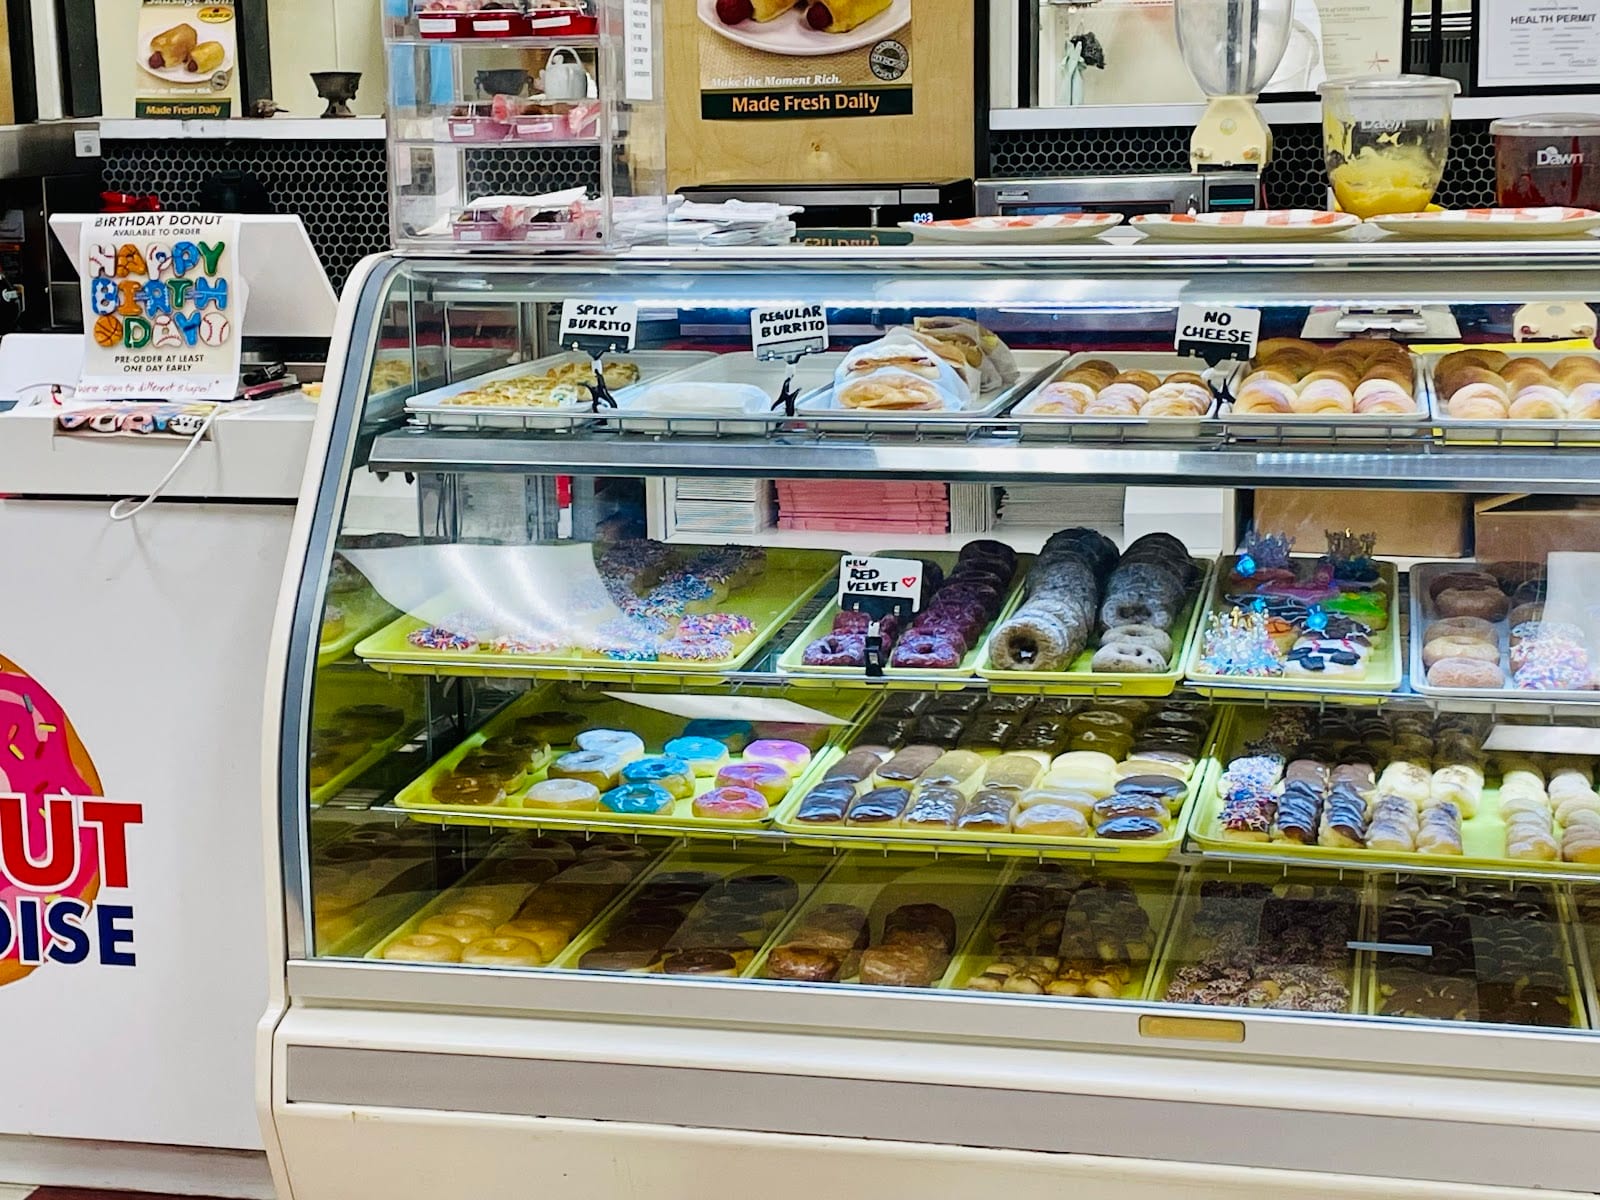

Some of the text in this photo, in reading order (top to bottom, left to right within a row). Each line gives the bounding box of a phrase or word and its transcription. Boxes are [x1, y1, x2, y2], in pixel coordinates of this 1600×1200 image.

[1510, 14, 1597, 24] HEALTH PERMIT
[711, 74, 842, 87] Make the Moment Rich.
[732, 93, 880, 113] Made Fresh Daily
[145, 105, 221, 116] Made Fresh Daily
[1537, 149, 1584, 165] Dawn
[95, 215, 223, 227] BIRTHDAY DONUT
[113, 229, 156, 237] AVAILABLE
[89, 241, 226, 280] HAPPY
[92, 277, 228, 318] BIRTH
[577, 304, 618, 316] SPICY
[759, 305, 822, 324] REGULAR
[568, 318, 632, 332] BURRITO
[1204, 311, 1231, 326] NO
[123, 311, 202, 349] DAY
[761, 320, 825, 338] BURRITO
[1182, 325, 1253, 343] CHEESE
[115, 355, 162, 363] PRE-ORDER
[179, 354, 204, 362] LEAST
[850, 568, 880, 580] RED
[847, 581, 898, 592] VELVET
